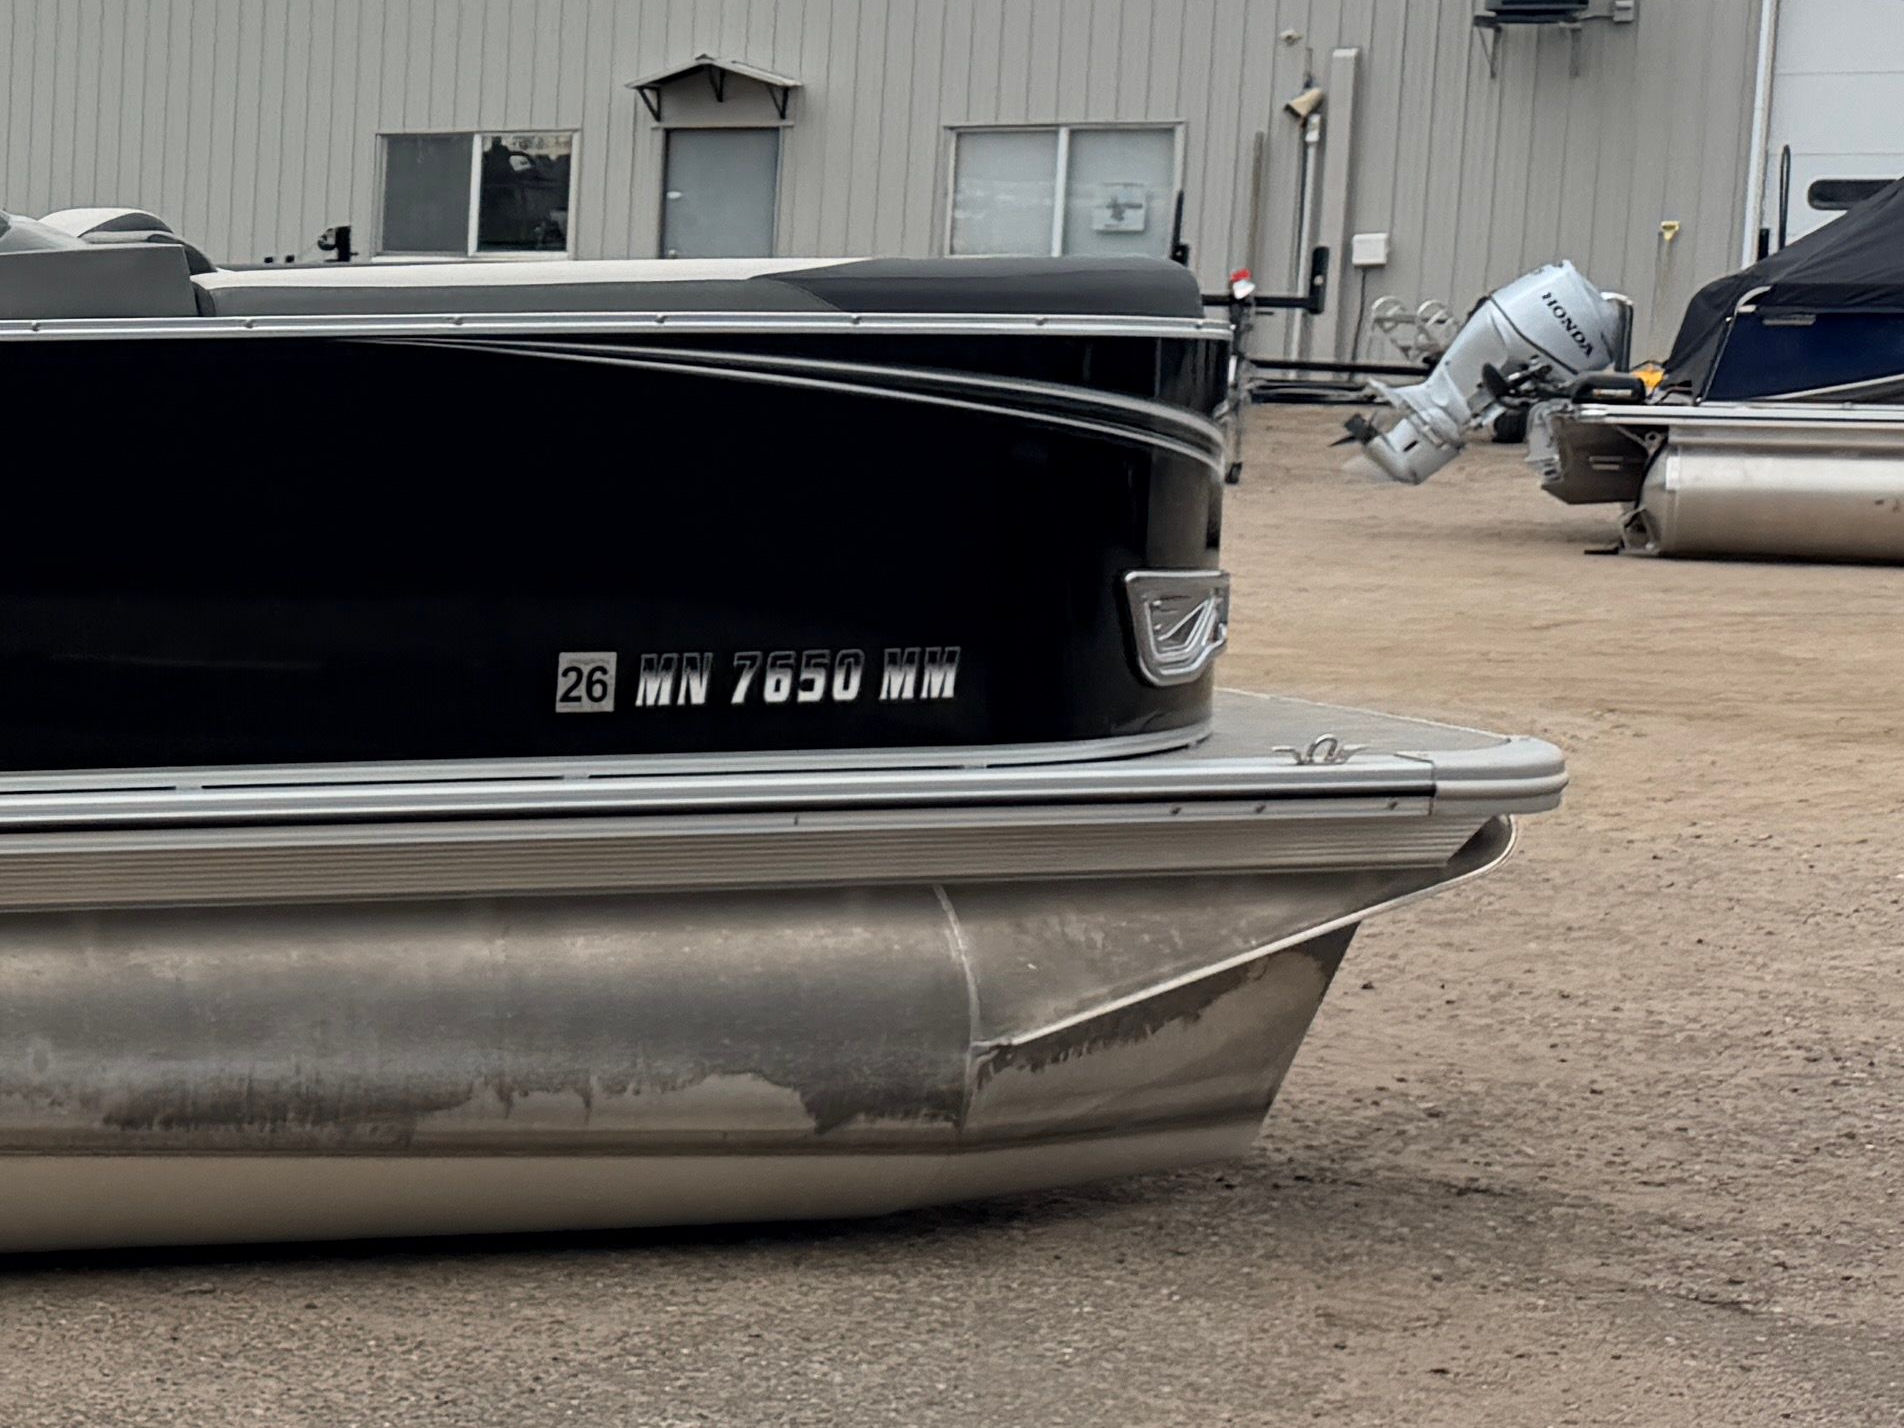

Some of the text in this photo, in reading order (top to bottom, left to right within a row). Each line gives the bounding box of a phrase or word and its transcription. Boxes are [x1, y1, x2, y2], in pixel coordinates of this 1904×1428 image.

[1541, 292, 1593, 358] HONDA
[559, 646, 962, 707] 26 MN 7650 MM
